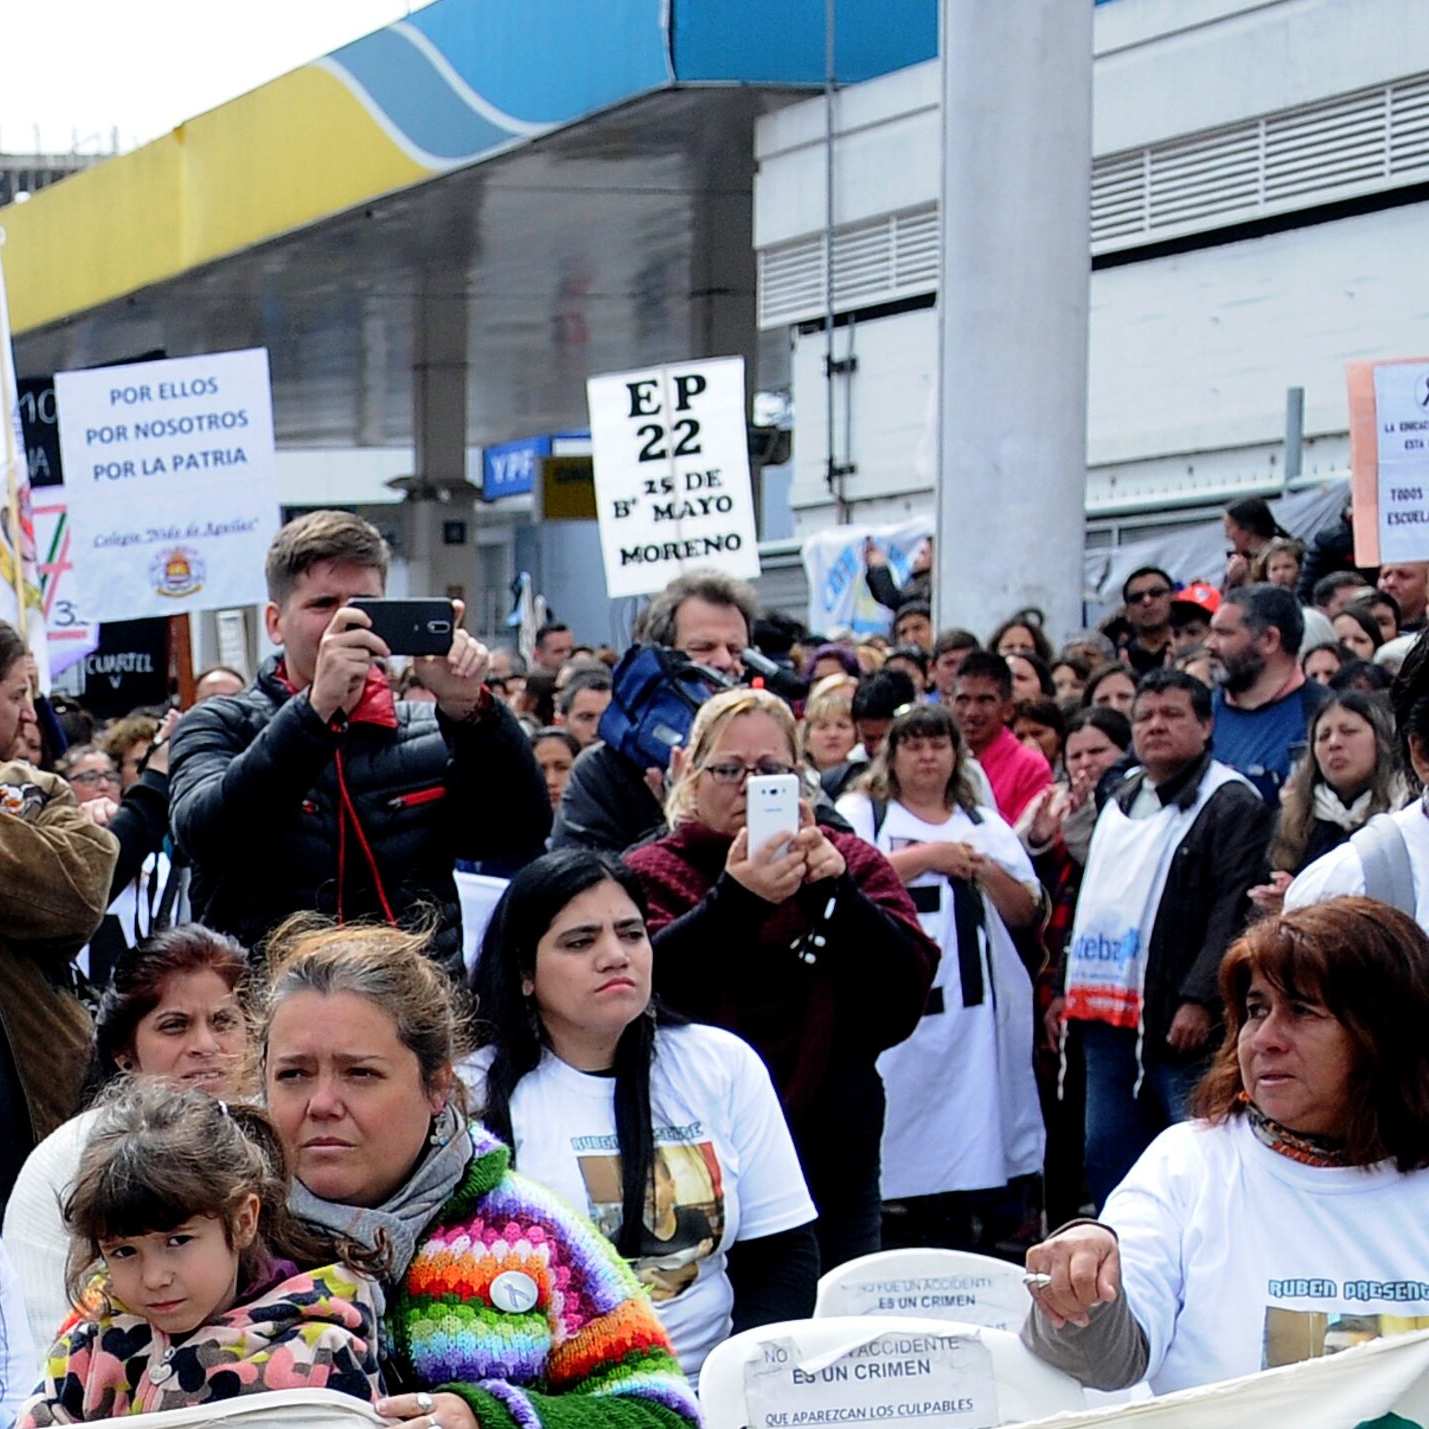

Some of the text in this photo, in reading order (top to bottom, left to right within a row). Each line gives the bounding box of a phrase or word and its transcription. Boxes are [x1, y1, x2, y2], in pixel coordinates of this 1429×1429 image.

[110, 377, 218, 405] POR ELLOS
[86, 409, 249, 445] POR NOSOTROS
[636, 419, 701, 462] 22
[93, 447, 248, 481] POR LA PATRIA
[644, 468, 723, 494] 25 DE
[653, 495, 733, 521] MAYO
[620, 533, 742, 566] MORENO
[86, 652, 153, 675] CUARTEL
[878, 1294, 976, 1309] ES UN CRIMEN
[764, 1348, 789, 1364] NO
[857, 1335, 961, 1359] ACCIDENTE
[821, 1364, 849, 1383] UN
[854, 1358, 932, 1380] CRIMEN
[765, 1397, 975, 1428] QUE APAREZCAN LOS CULPABLES
